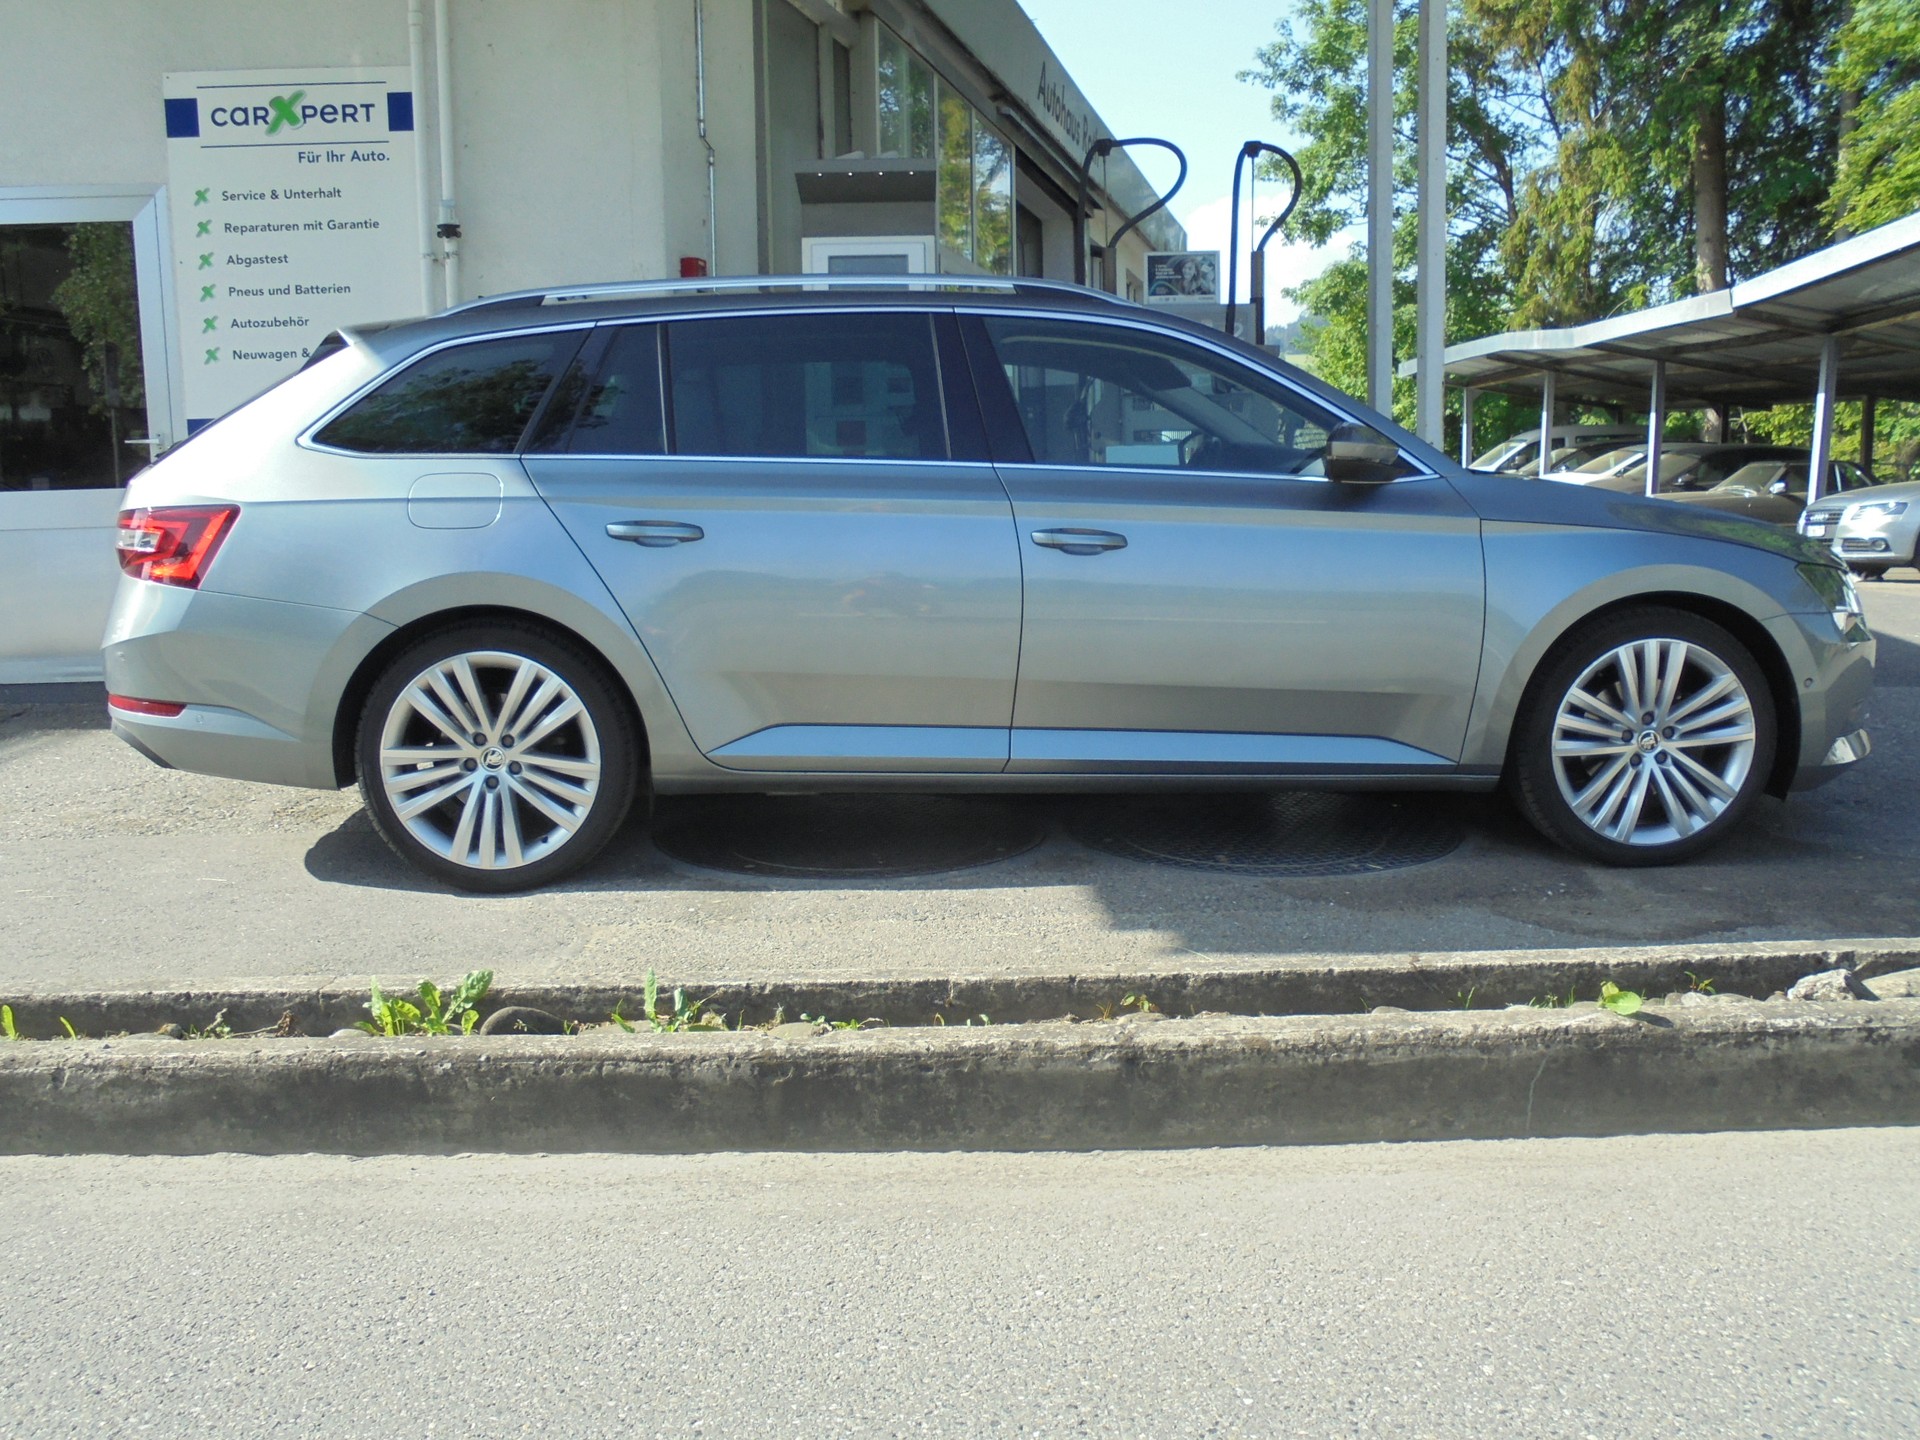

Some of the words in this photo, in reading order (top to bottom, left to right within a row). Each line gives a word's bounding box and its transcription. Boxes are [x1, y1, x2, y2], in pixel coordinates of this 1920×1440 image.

[1037, 61, 1081, 146] Autohaus
[298, 150, 322, 164] Für
[327, 149, 346, 163] Ihr
[351, 149, 390, 162] Auto.
[222, 189, 266, 202] Service
[271, 189, 280, 200] &
[284, 187, 342, 200] Unterhalt
[224, 222, 300, 236] Reparaturen
[304, 220, 324, 231] mit
[327, 219, 380, 231] Garantie
[227, 254, 289, 268] Abgastest
[228, 286, 265, 297] Pneus
[268, 284, 291, 296] und
[295, 283, 351, 295] Batterien
[230, 317, 310, 329] Autozubehör
[232, 349, 298, 362] Neuwagen
[301, 348, 311, 359] &
